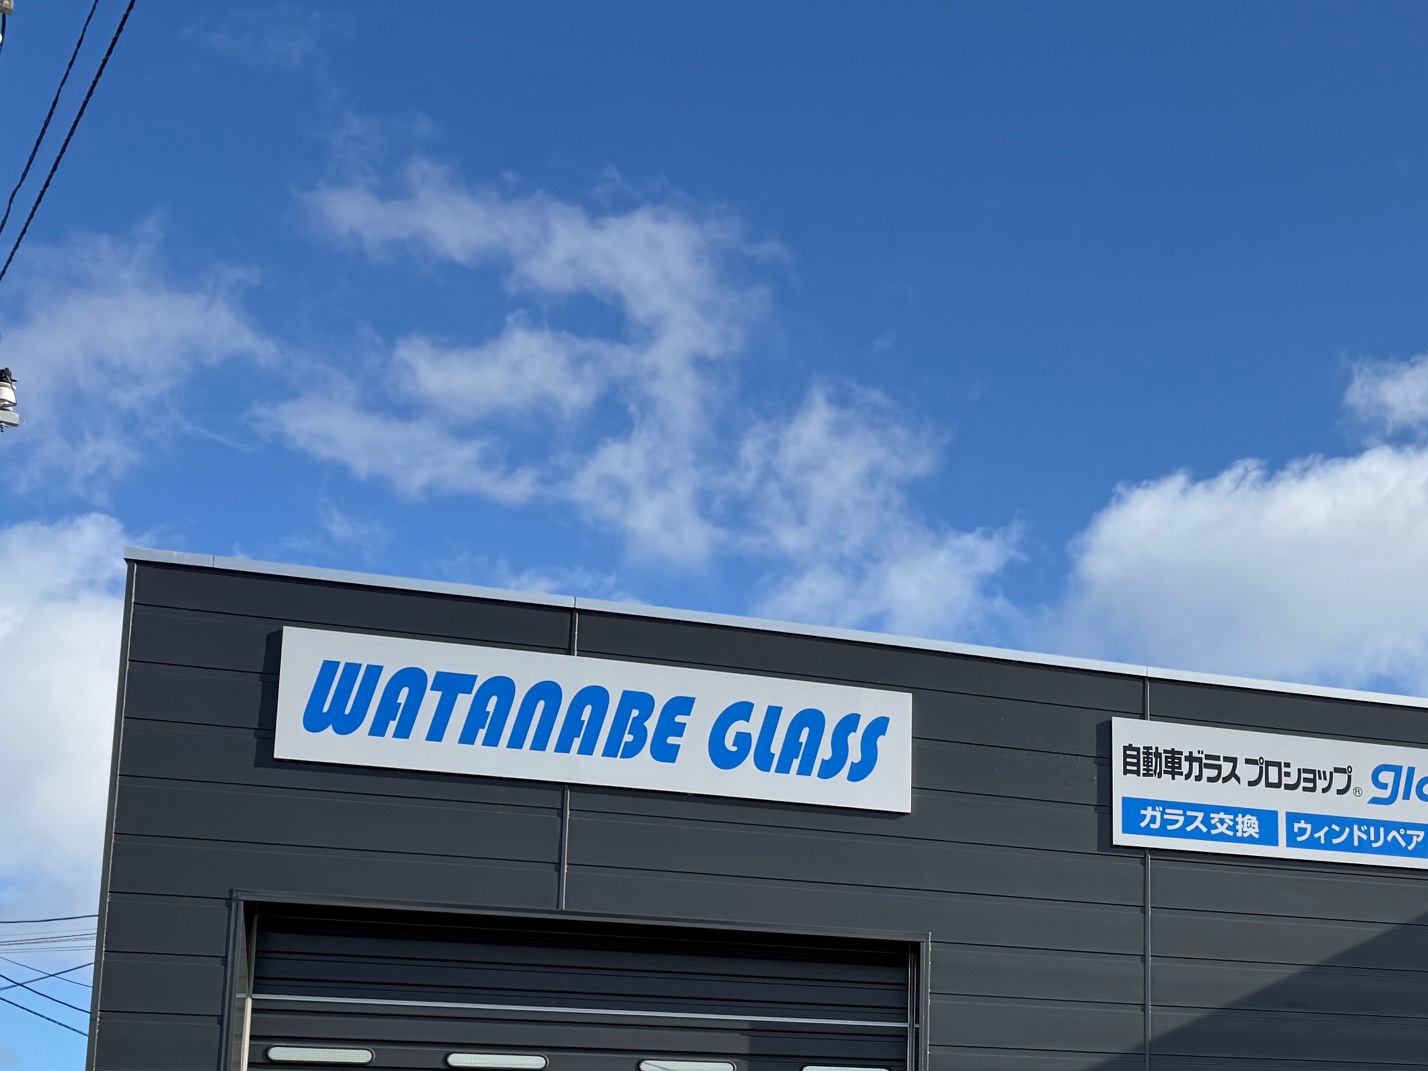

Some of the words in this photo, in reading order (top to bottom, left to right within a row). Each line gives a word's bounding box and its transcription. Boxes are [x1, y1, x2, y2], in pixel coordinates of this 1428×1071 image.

[301, 659, 696, 764] WATANABE
[707, 699, 890, 783] GLASS
[1138, 805, 1261, 839] ガラス交換
[1292, 819, 1426, 851] ウィンドリペア
